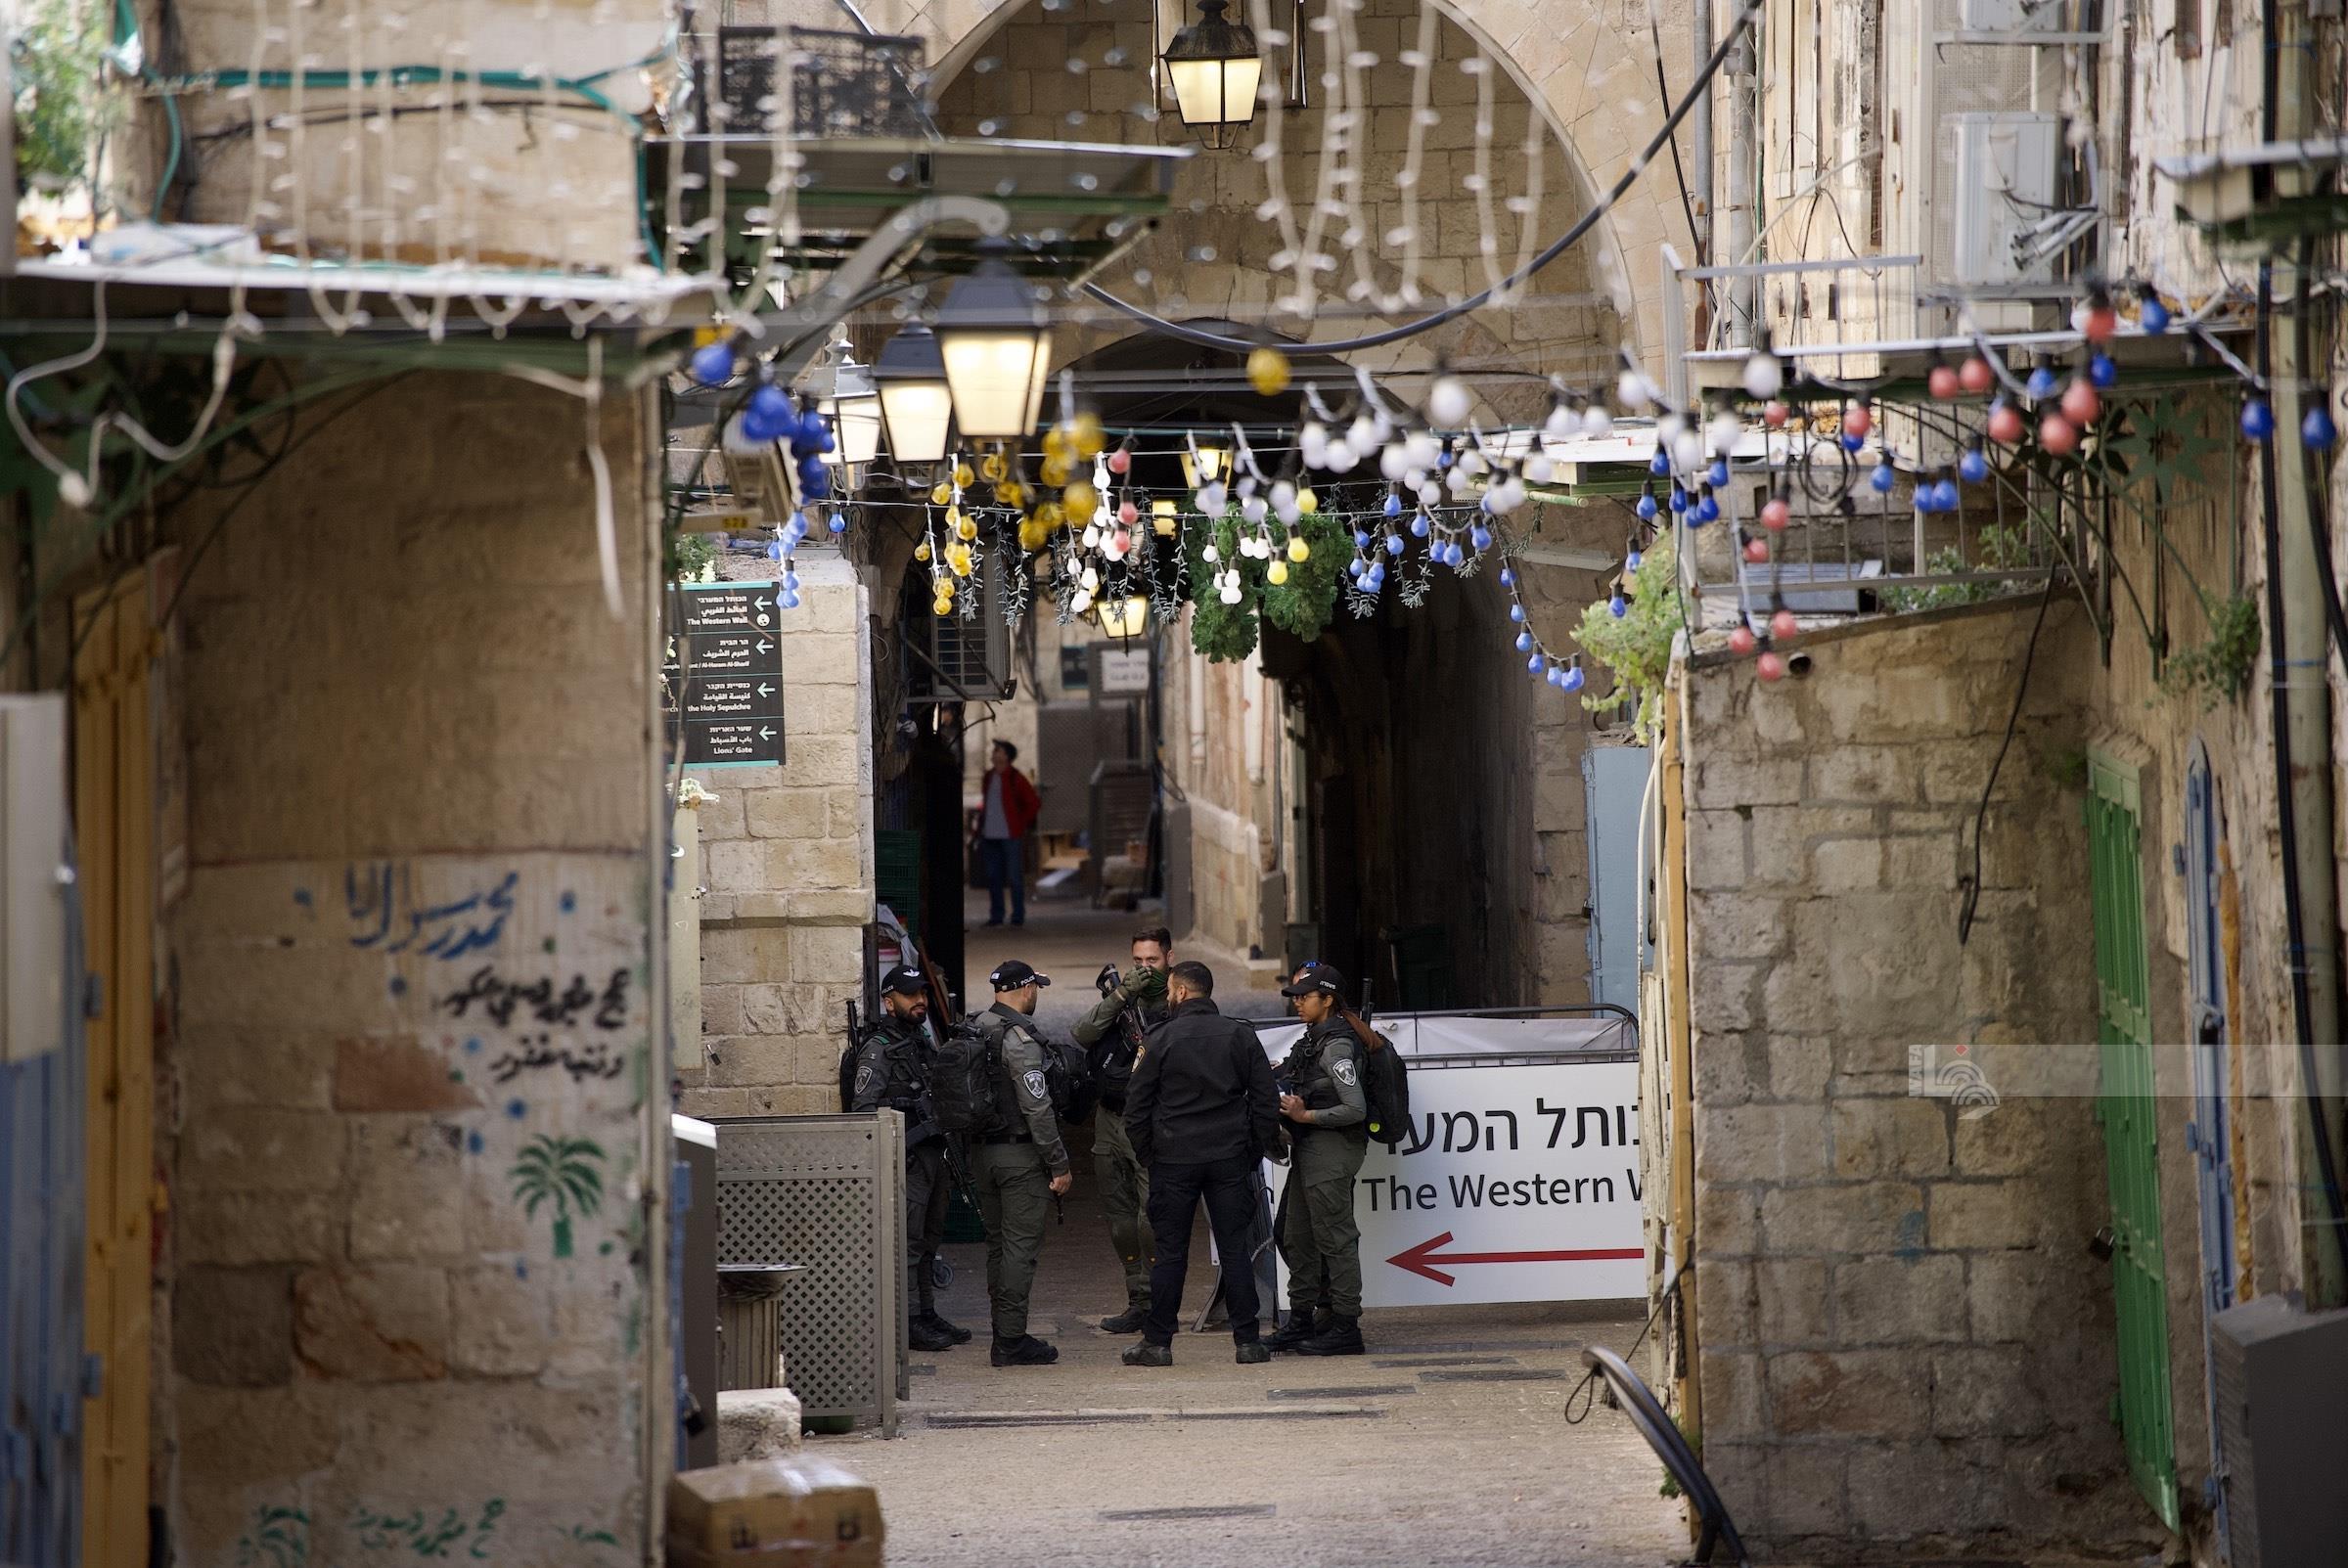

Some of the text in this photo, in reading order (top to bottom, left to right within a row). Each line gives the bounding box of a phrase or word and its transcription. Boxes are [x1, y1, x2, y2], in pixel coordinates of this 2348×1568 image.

[702, 649, 749, 658] الحرم الشريف
[702, 693, 751, 701] كنيسة القيامة
[717, 703, 751, 712] Sepulchre
[1536, 1097, 1641, 1148] ותל
[1361, 1175, 1438, 1211] The
[1448, 1173, 1615, 1209] Western
